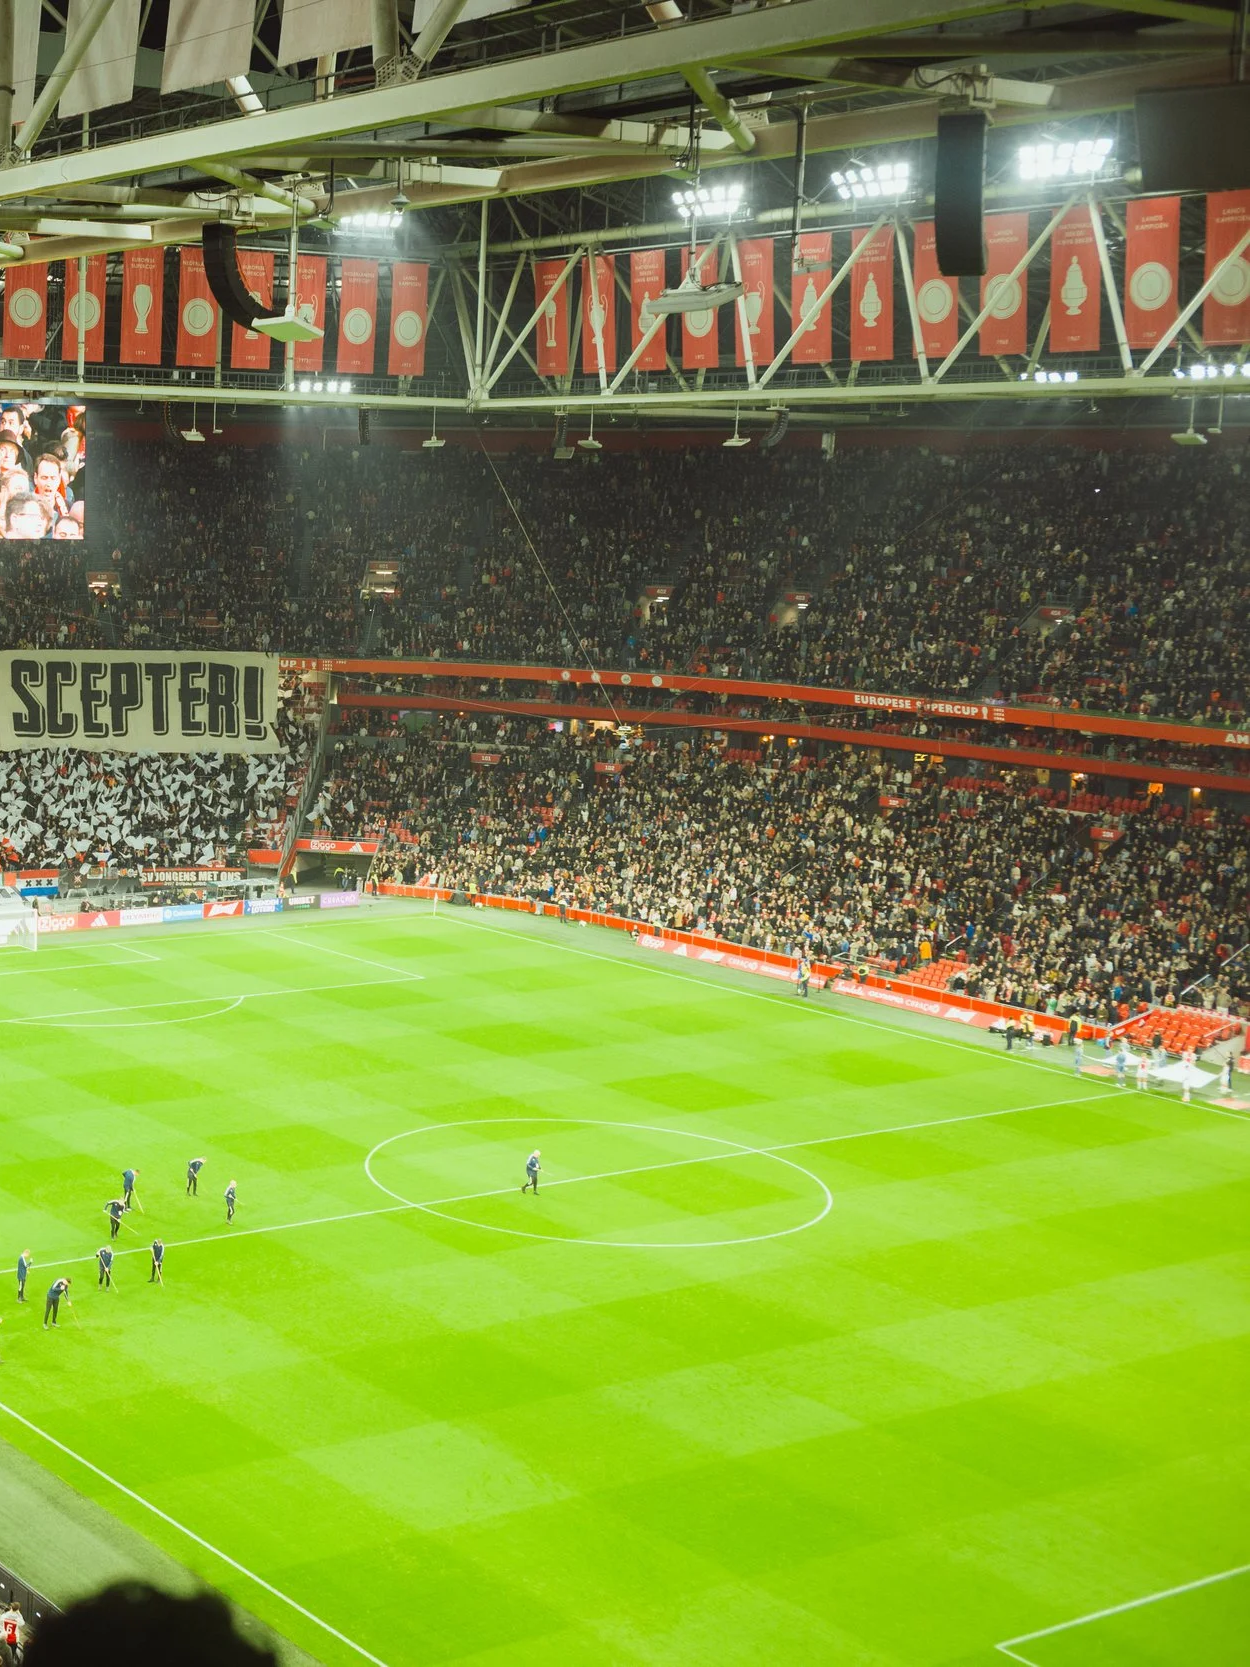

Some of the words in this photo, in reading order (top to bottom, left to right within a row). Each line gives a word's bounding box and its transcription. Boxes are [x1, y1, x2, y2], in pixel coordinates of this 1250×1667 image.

[10, 659, 268, 741] SCEPTER!
[854, 694, 912, 709] EUROPESE
[916, 701, 979, 716] SPERCUP
[1224, 733, 1250, 744] AM
[155, 871, 197, 882] JONGENS
[198, 871, 219, 881] MET
[221, 871, 241, 881] ONS
